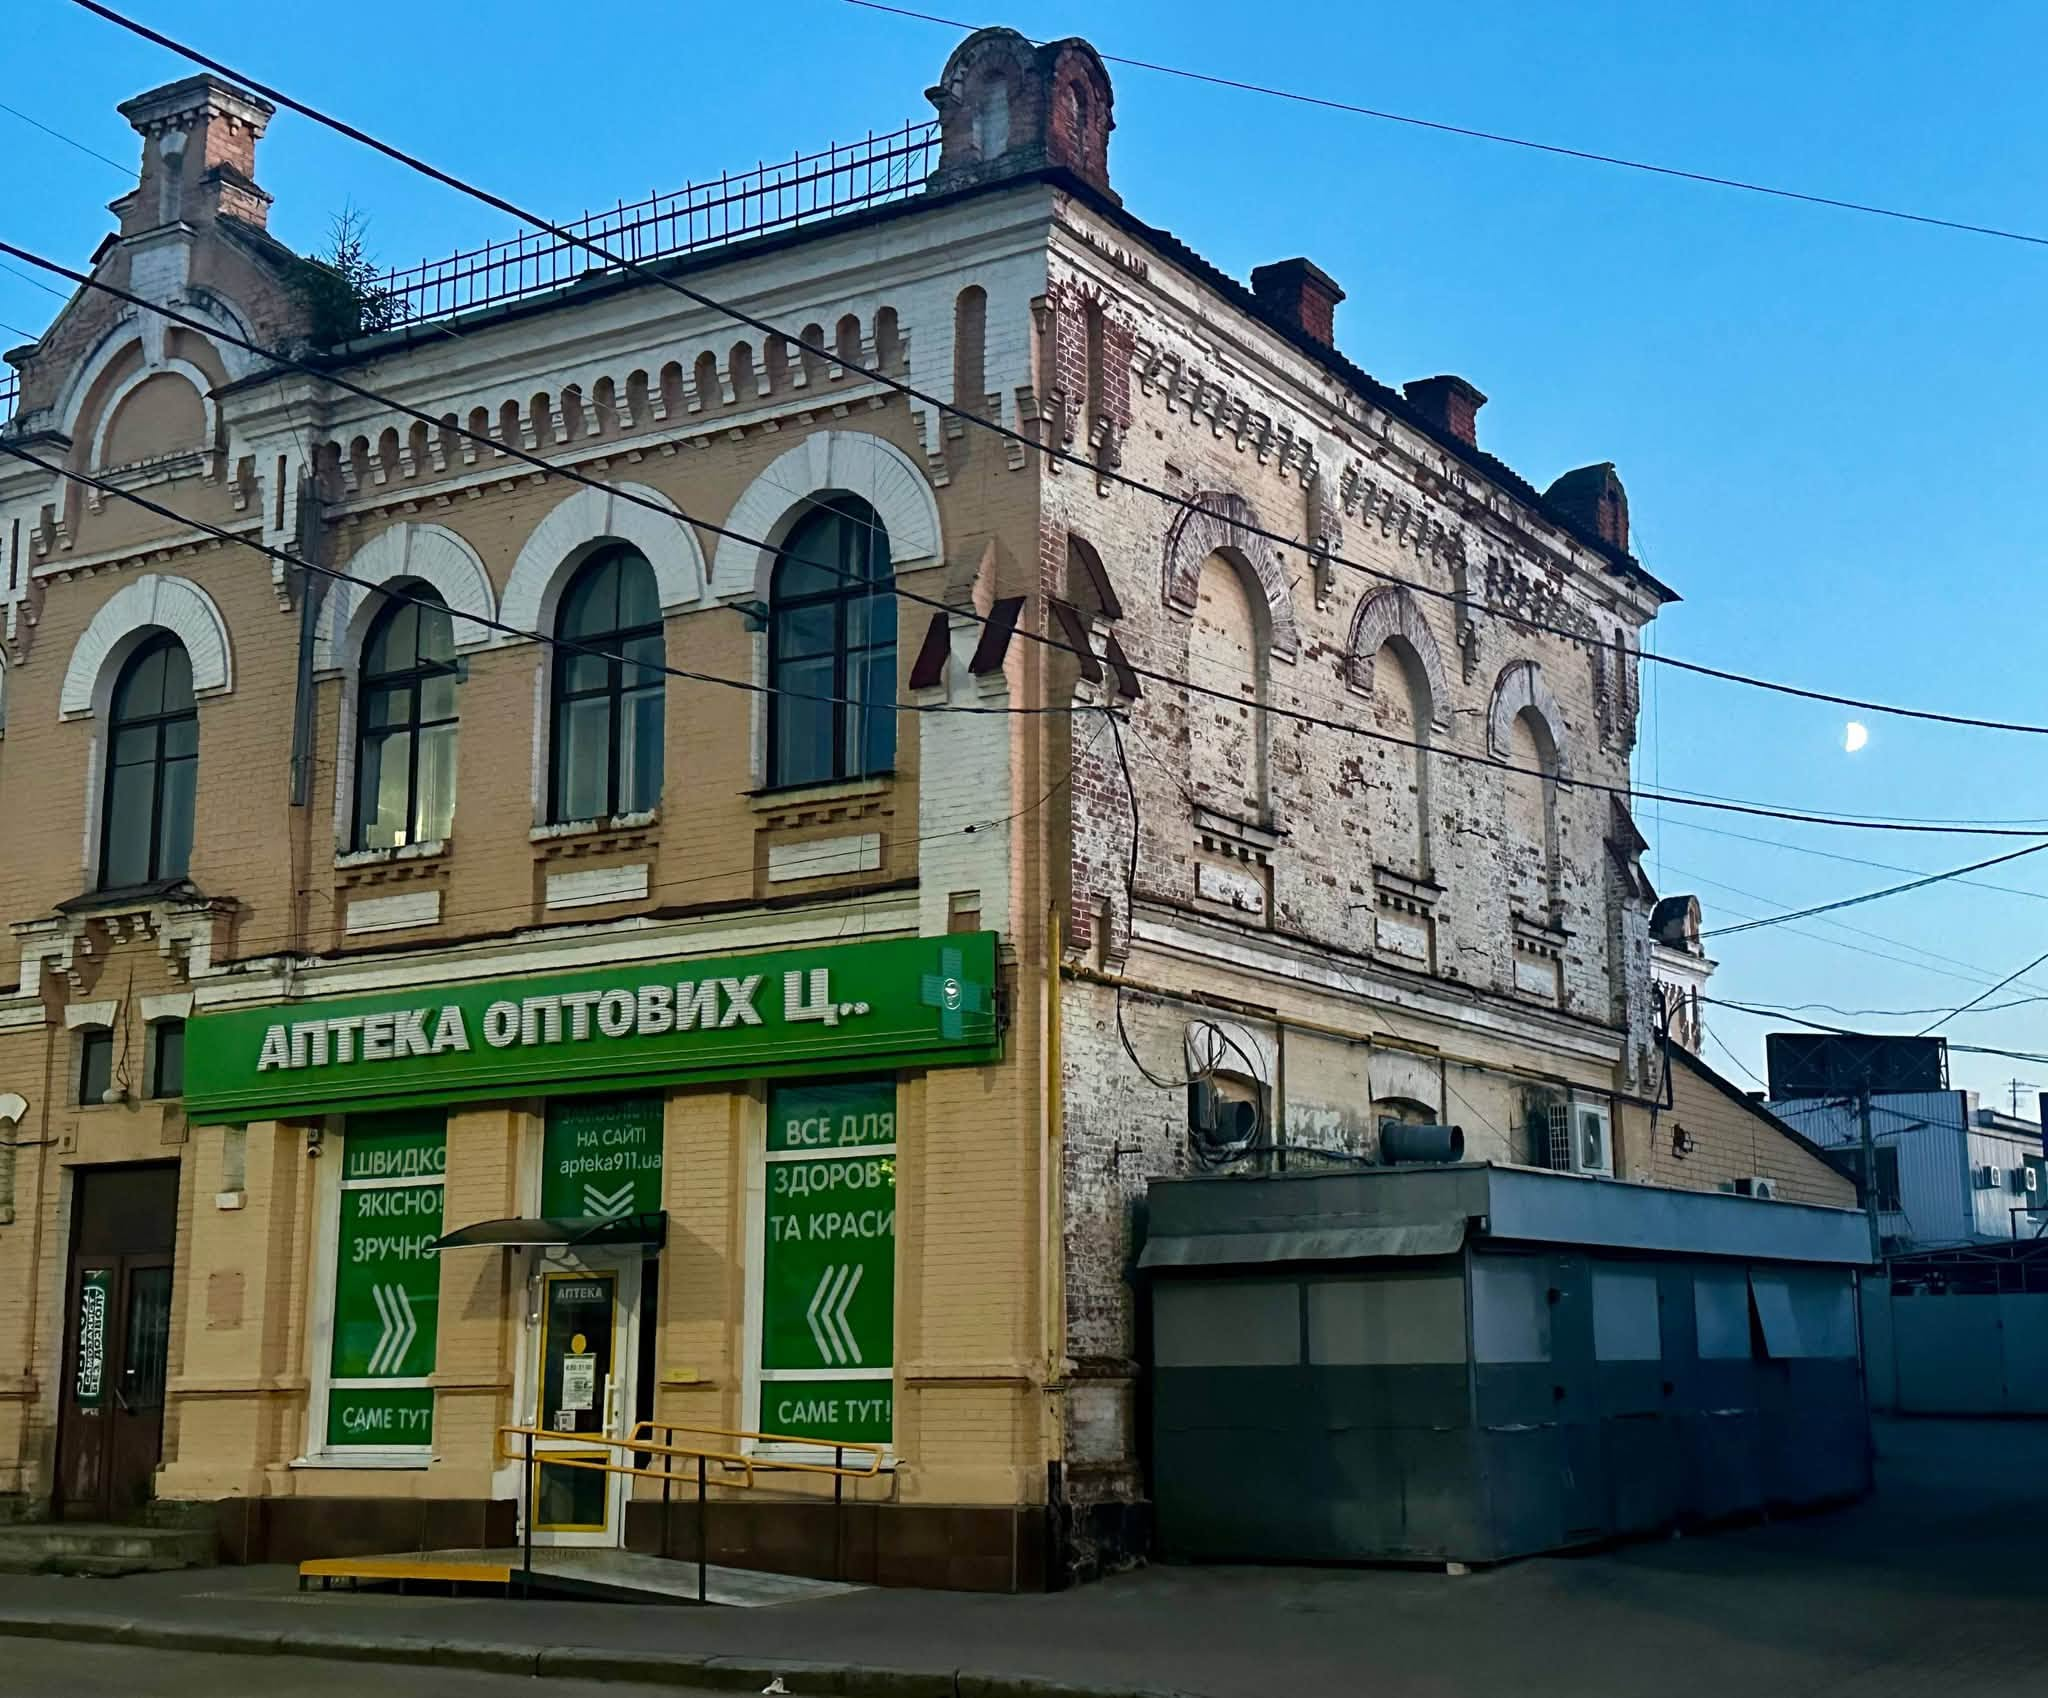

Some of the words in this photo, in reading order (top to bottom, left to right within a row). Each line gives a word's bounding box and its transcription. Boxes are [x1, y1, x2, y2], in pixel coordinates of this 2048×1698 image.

[256, 1005, 471, 1072] АПТЕКА
[482, 974, 763, 1048] ОПТОВИХ
[577, 1130, 598, 1147] НА
[603, 1125, 646, 1145] САЙТІ
[786, 1117, 831, 1146] ВСЕ
[838, 1113, 894, 1145] ДЛЯ
[350, 1147, 447, 1177] ШВИДКО
[559, 1151, 663, 1177] apteka911.ua
[357, 1189, 444, 1217] ЯКІСНО!
[770, 1214, 802, 1242] ТА
[808, 1209, 895, 1240] КРАСИ
[557, 1286, 604, 1299] АПТЕКА
[343, 1407, 393, 1429] САМЕ
[398, 1407, 431, 1430] ТУТ
[778, 1401, 838, 1424] САМЕ
[845, 1400, 892, 1424] ТУТ!
